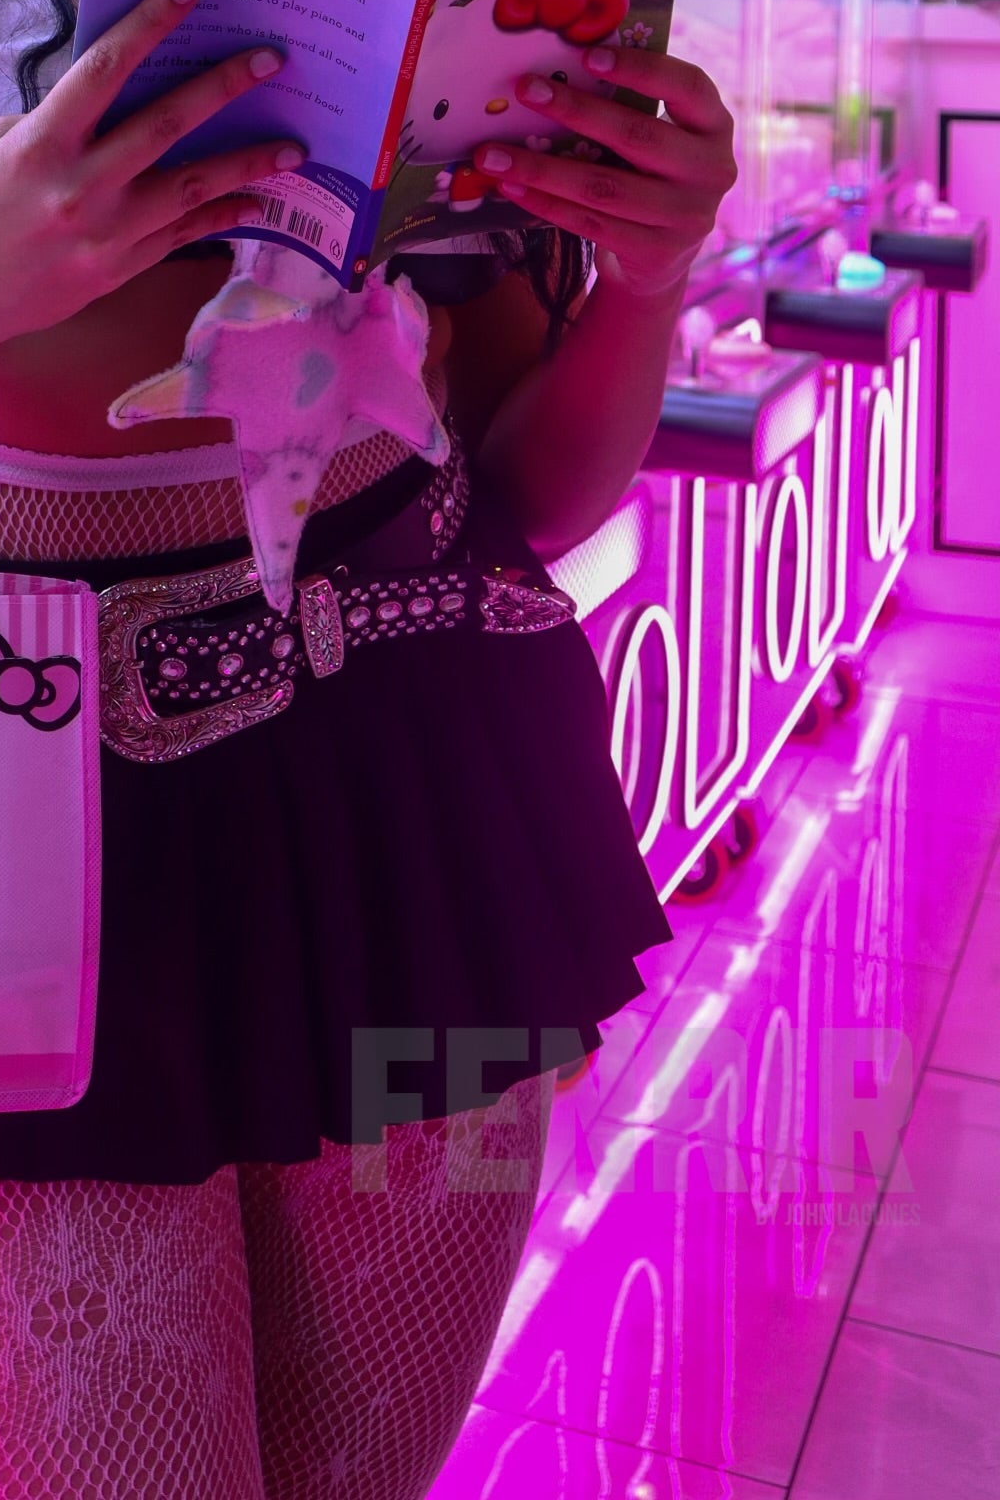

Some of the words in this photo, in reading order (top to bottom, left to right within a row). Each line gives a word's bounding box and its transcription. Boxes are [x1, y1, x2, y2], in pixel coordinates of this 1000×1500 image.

[282, 0, 308, 16] play
[310, 9, 343, 30] piano
[345, 26, 365, 42] and
[413, 0, 430, 22] Story
[154, 55, 169, 68] of
[170, 55, 192, 67] the
[197, 22, 223, 33] icon
[227, 23, 251, 36] who
[255, 28, 265, 38] is
[269, 29, 316, 53] beloved
[319, 48, 333, 61] all
[335, 57, 358, 76] over
[408, 34, 422, 54] Hello
[260, 80, 313, 100] ustrated
[315, 95, 345, 117] book!
[296, 178, 346, 214] Workshop
